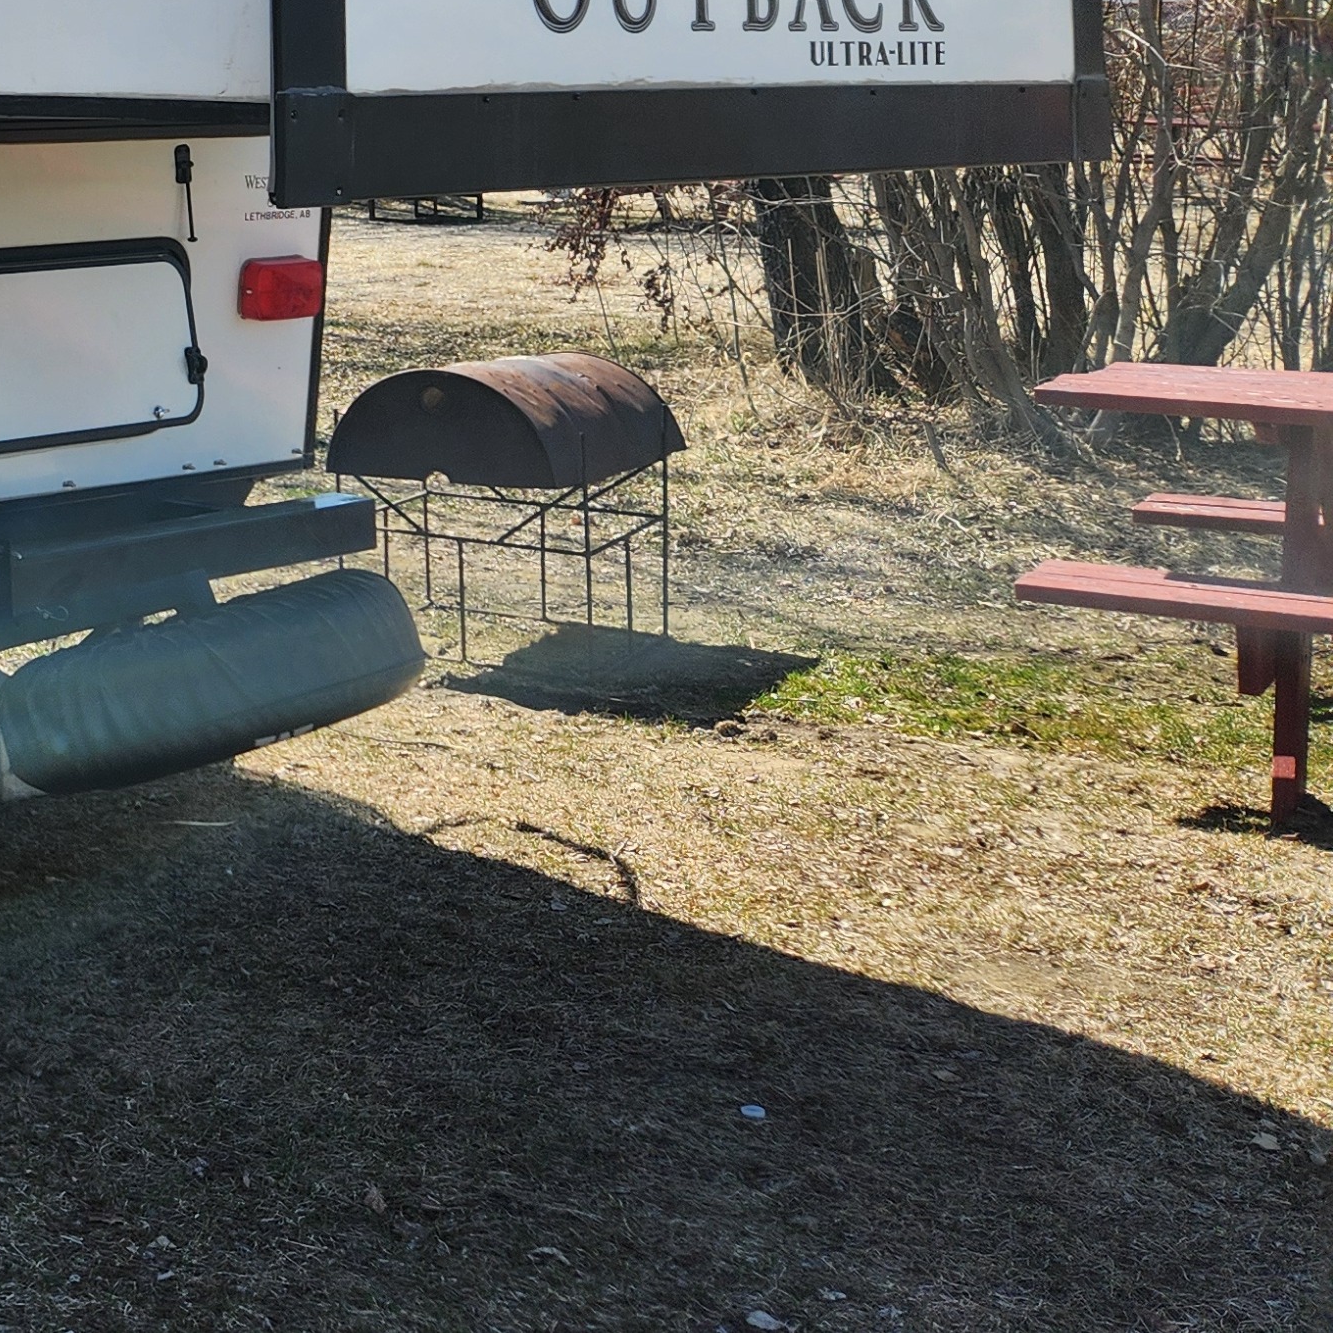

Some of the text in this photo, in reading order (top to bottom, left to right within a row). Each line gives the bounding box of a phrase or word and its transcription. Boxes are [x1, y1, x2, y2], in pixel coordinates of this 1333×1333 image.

[809, 40, 946, 67] ULTRA-LITE
[244, 209, 311, 221] LETHBRIDGE, AB
